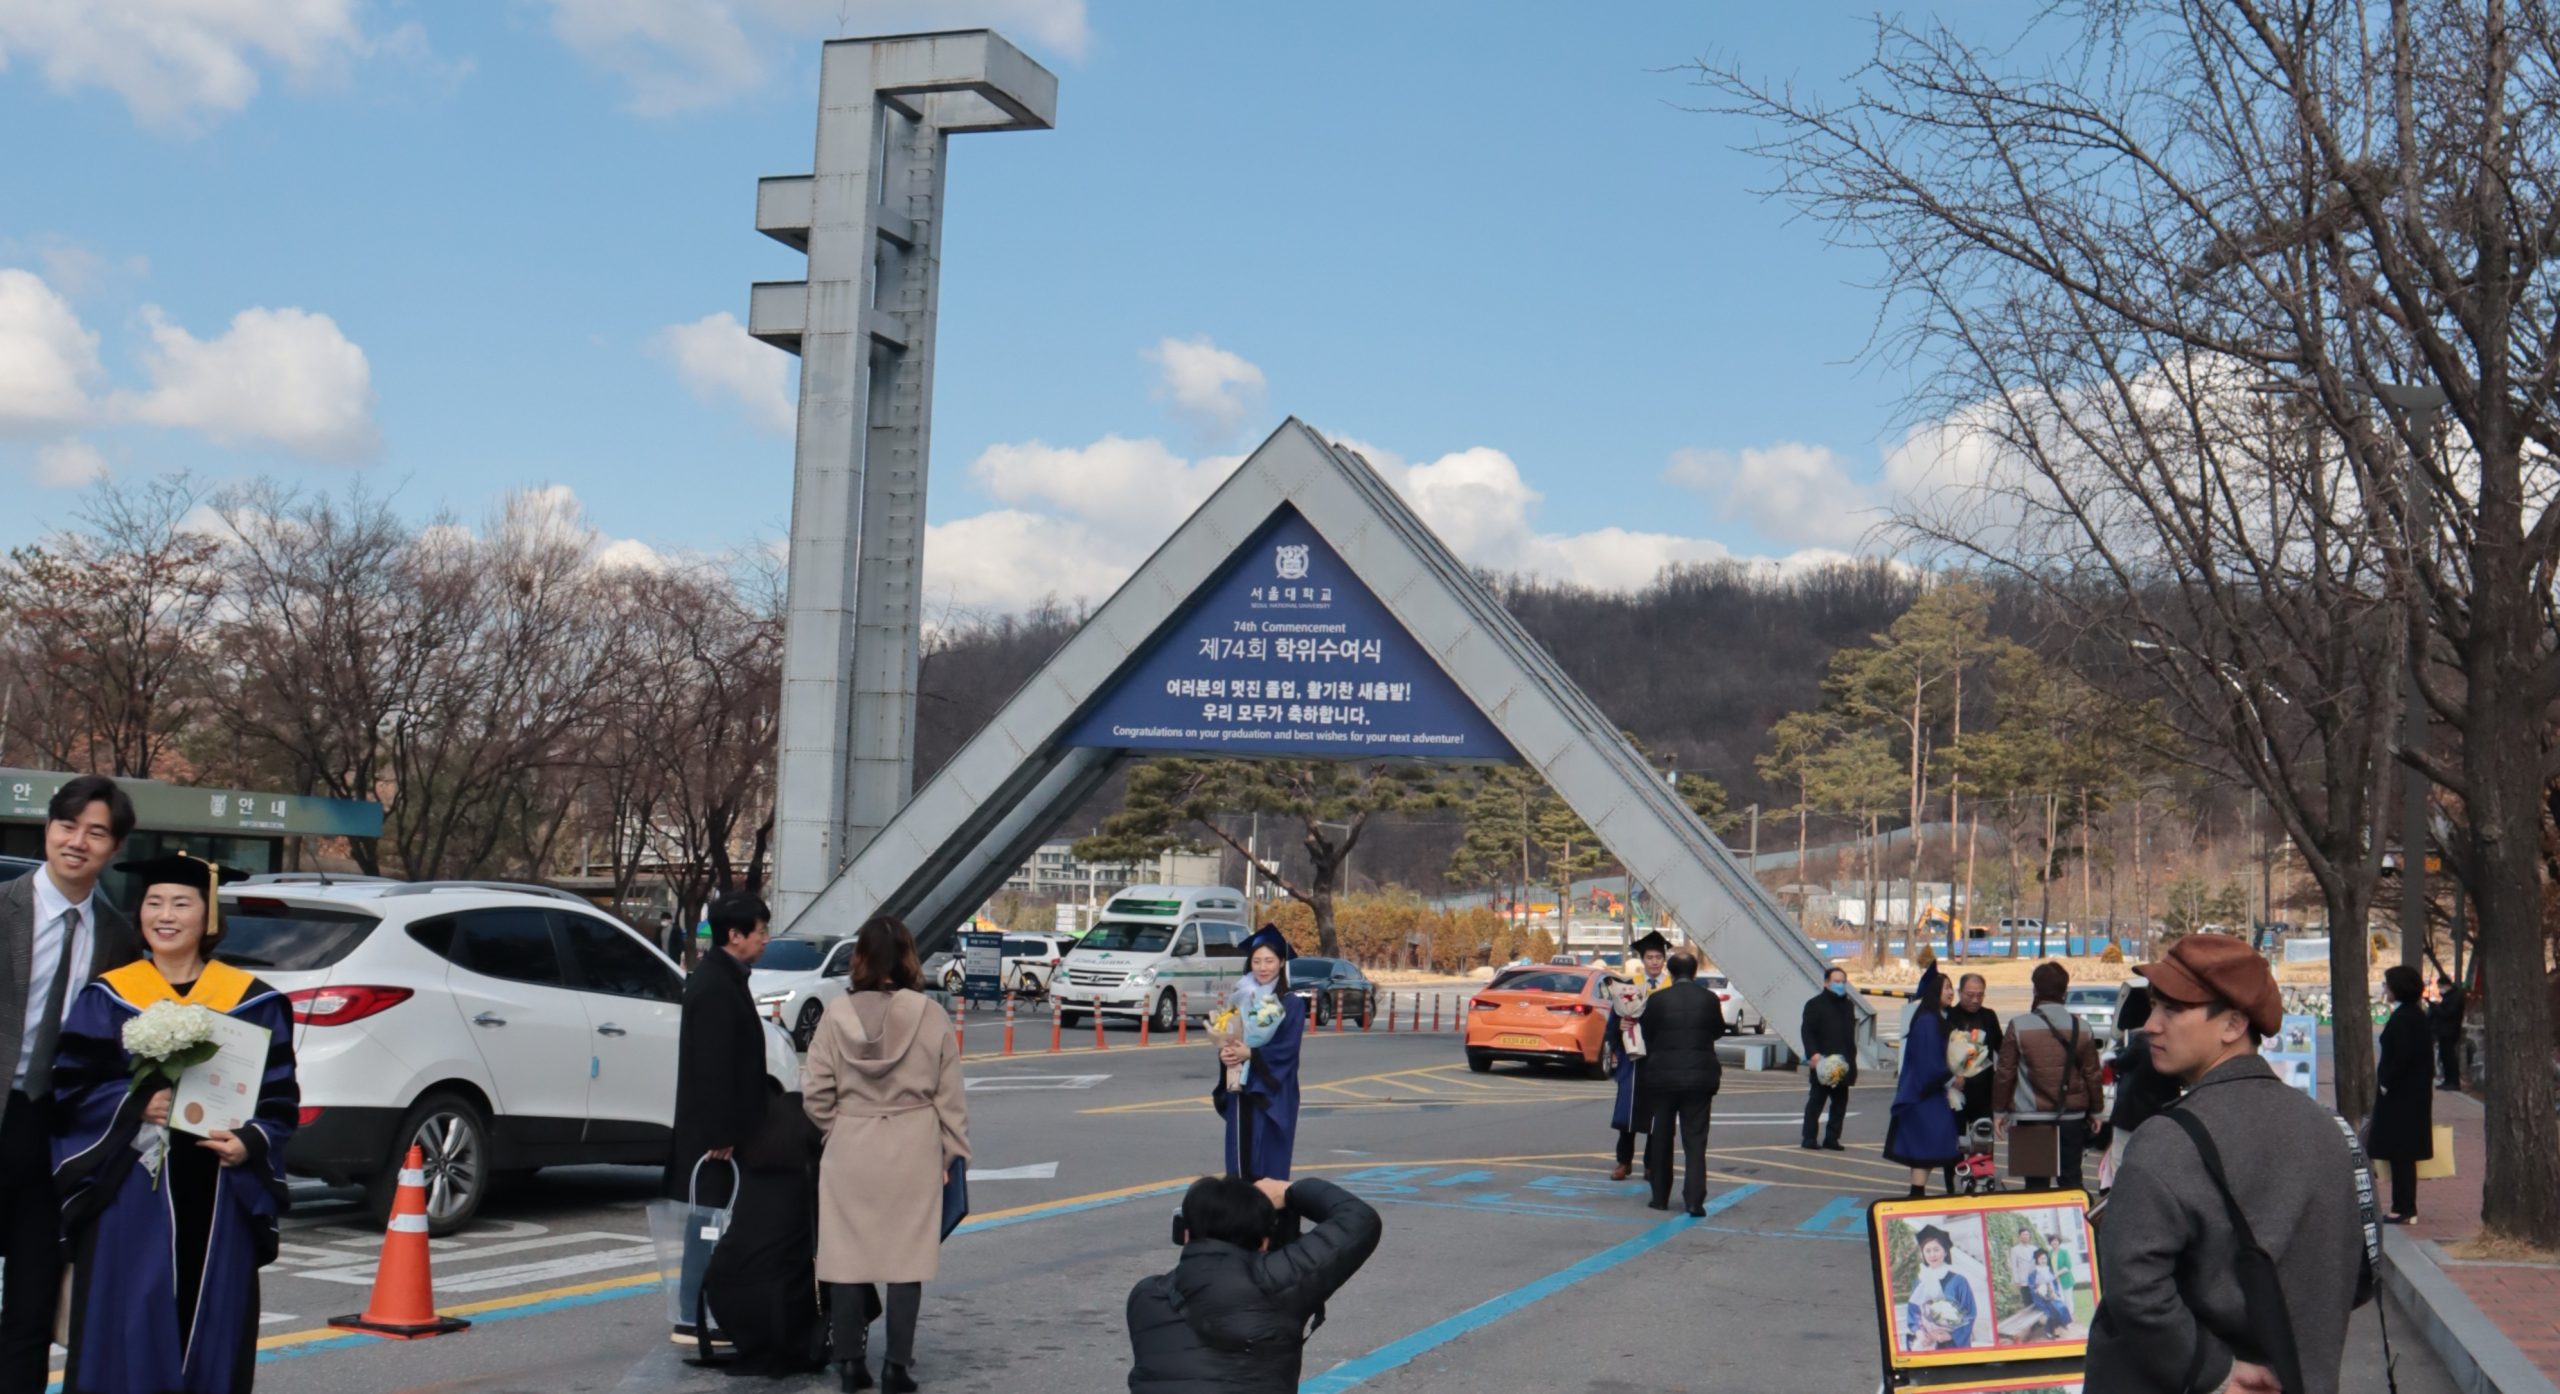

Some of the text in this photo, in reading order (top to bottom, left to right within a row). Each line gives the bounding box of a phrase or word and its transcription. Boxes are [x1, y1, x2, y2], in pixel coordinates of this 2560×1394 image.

[1250, 586, 1332, 602] 서울대학교
[1233, 620, 1346, 633] 74th Commencement
[1199, 637, 1382, 664] 제74회 학위수여식
[1166, 678, 1411, 701] 여러분의 멋진 졸업, 활기찬 새출발!
[1202, 703, 1371, 725] 우리 모두가 축하합니다.
[1112, 725, 1464, 744] Congratulations on your graduation and best wishes for your next adventure!
